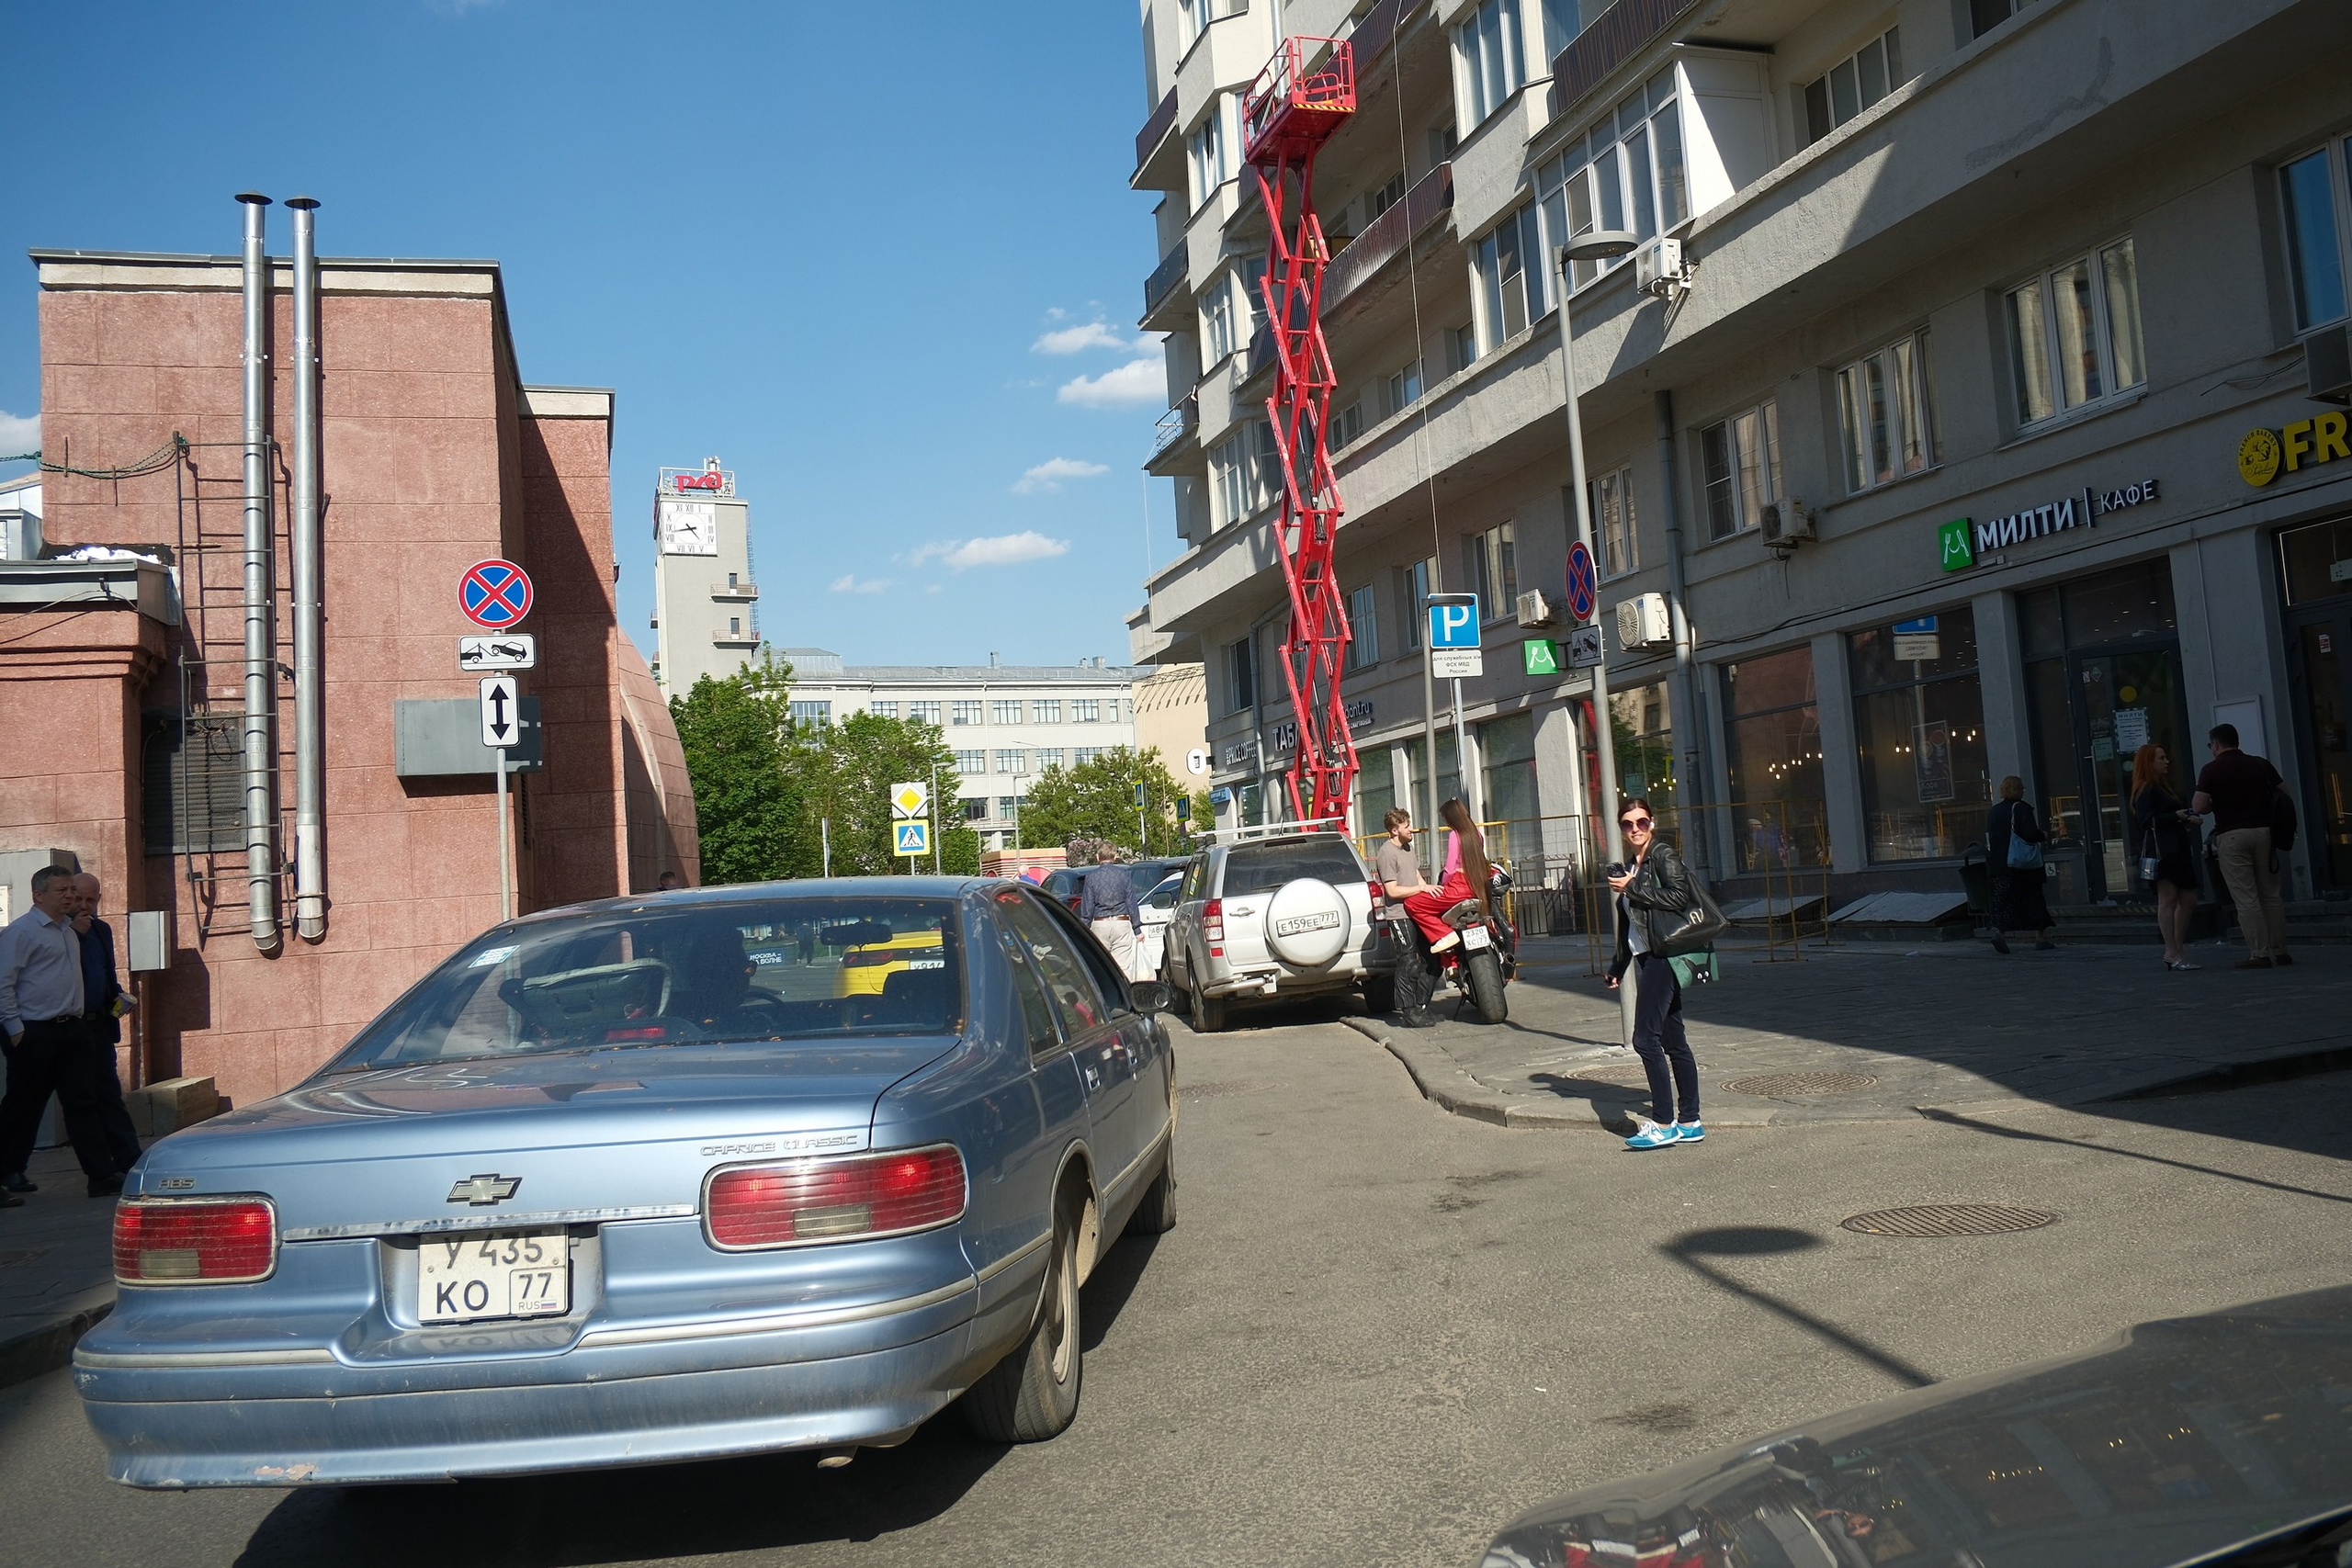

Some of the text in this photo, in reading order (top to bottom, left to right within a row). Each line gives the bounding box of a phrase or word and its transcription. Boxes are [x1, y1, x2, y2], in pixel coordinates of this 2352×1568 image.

[2239, 430, 2277, 457] FRENCH BAKERY
[1977, 479, 2155, 552] МИЛТИ КАФЕ
[1443, 604, 1470, 642] P
[1281, 912, 1335, 931] Е159ЕЕ 777
[1465, 928, 1485, 938] 2320
[1478, 936, 1487, 944] 77
[700, 1134, 857, 1156] CAPRICE CLASSIC
[158, 1177, 195, 1190] ABS
[478, 1230, 544, 1267] 435
[436, 1271, 551, 1315] КО 77
[517, 1300, 541, 1311] RUS
